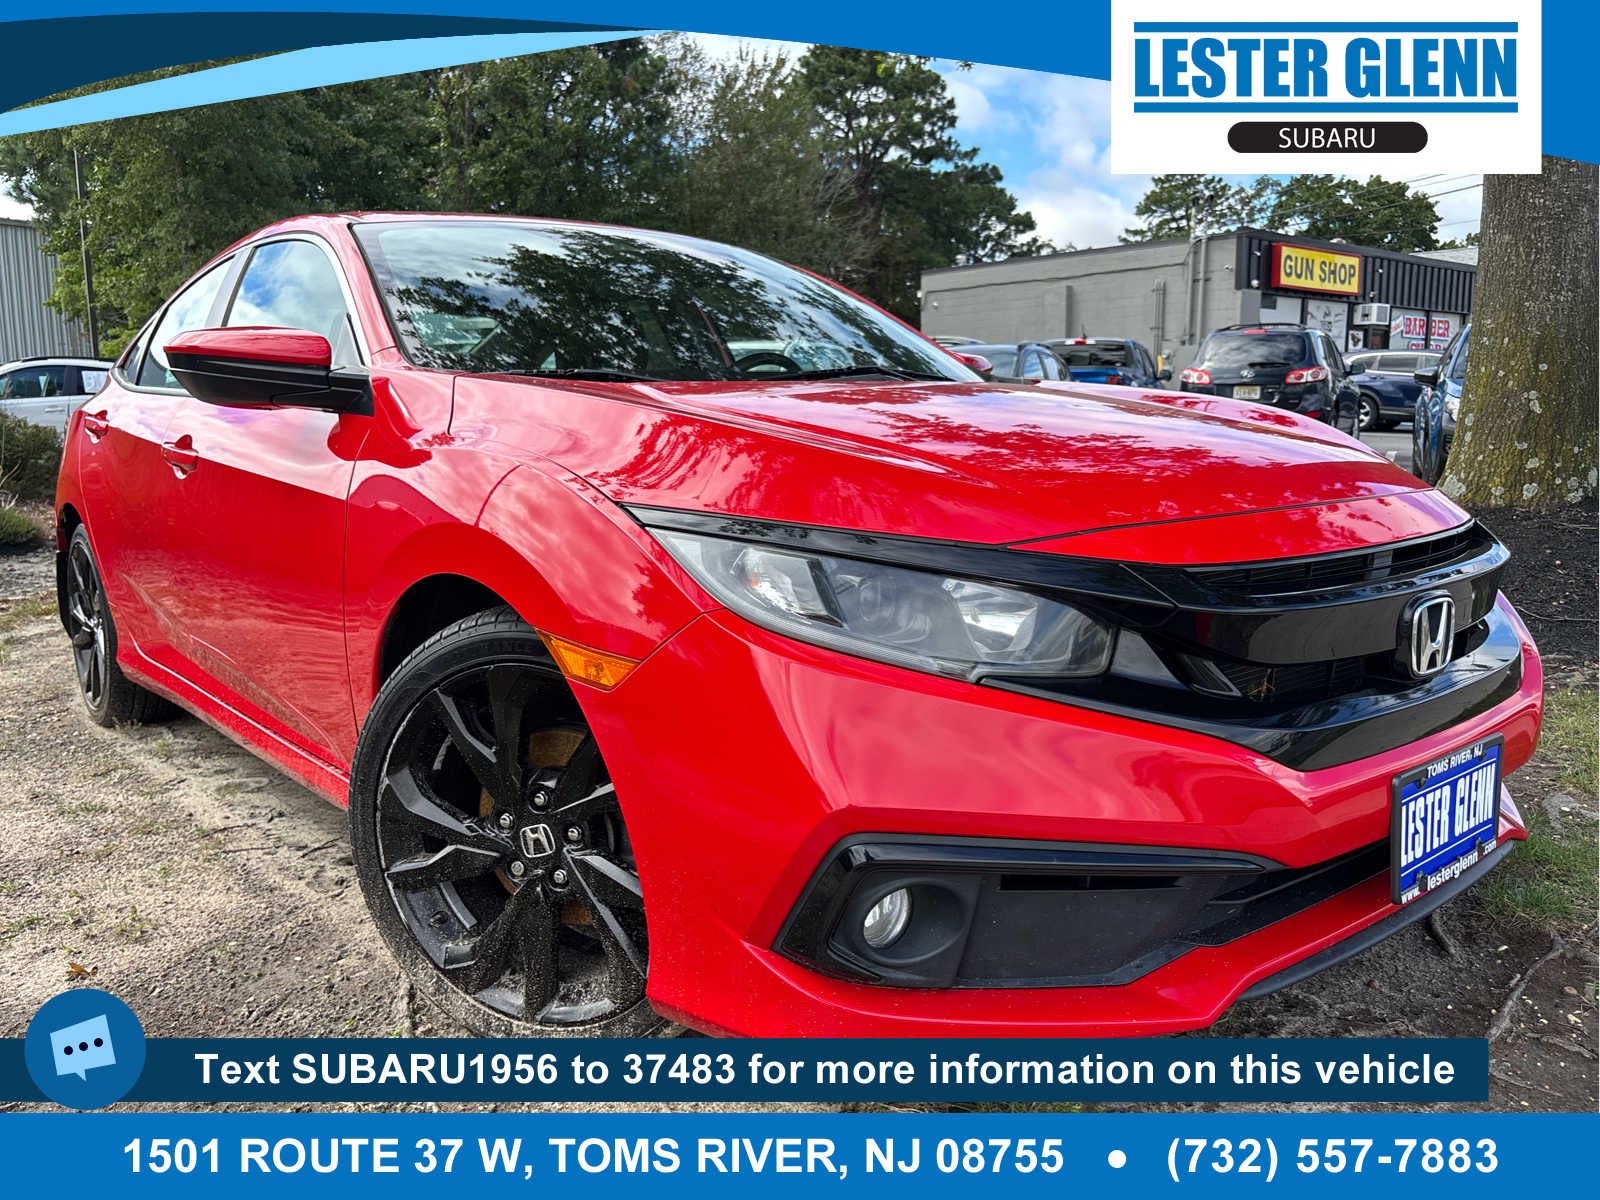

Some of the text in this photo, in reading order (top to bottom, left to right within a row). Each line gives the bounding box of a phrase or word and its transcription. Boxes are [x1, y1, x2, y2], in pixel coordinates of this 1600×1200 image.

[1283, 254, 1356, 286] GUN SHOP
[1404, 317, 1450, 338] BARBER
[1427, 759, 1449, 778] TOMS
[1474, 744, 1483, 758] NJ
[1401, 763, 1496, 868] LESTER GLENN
[1427, 850, 1479, 891] lesterglenn
